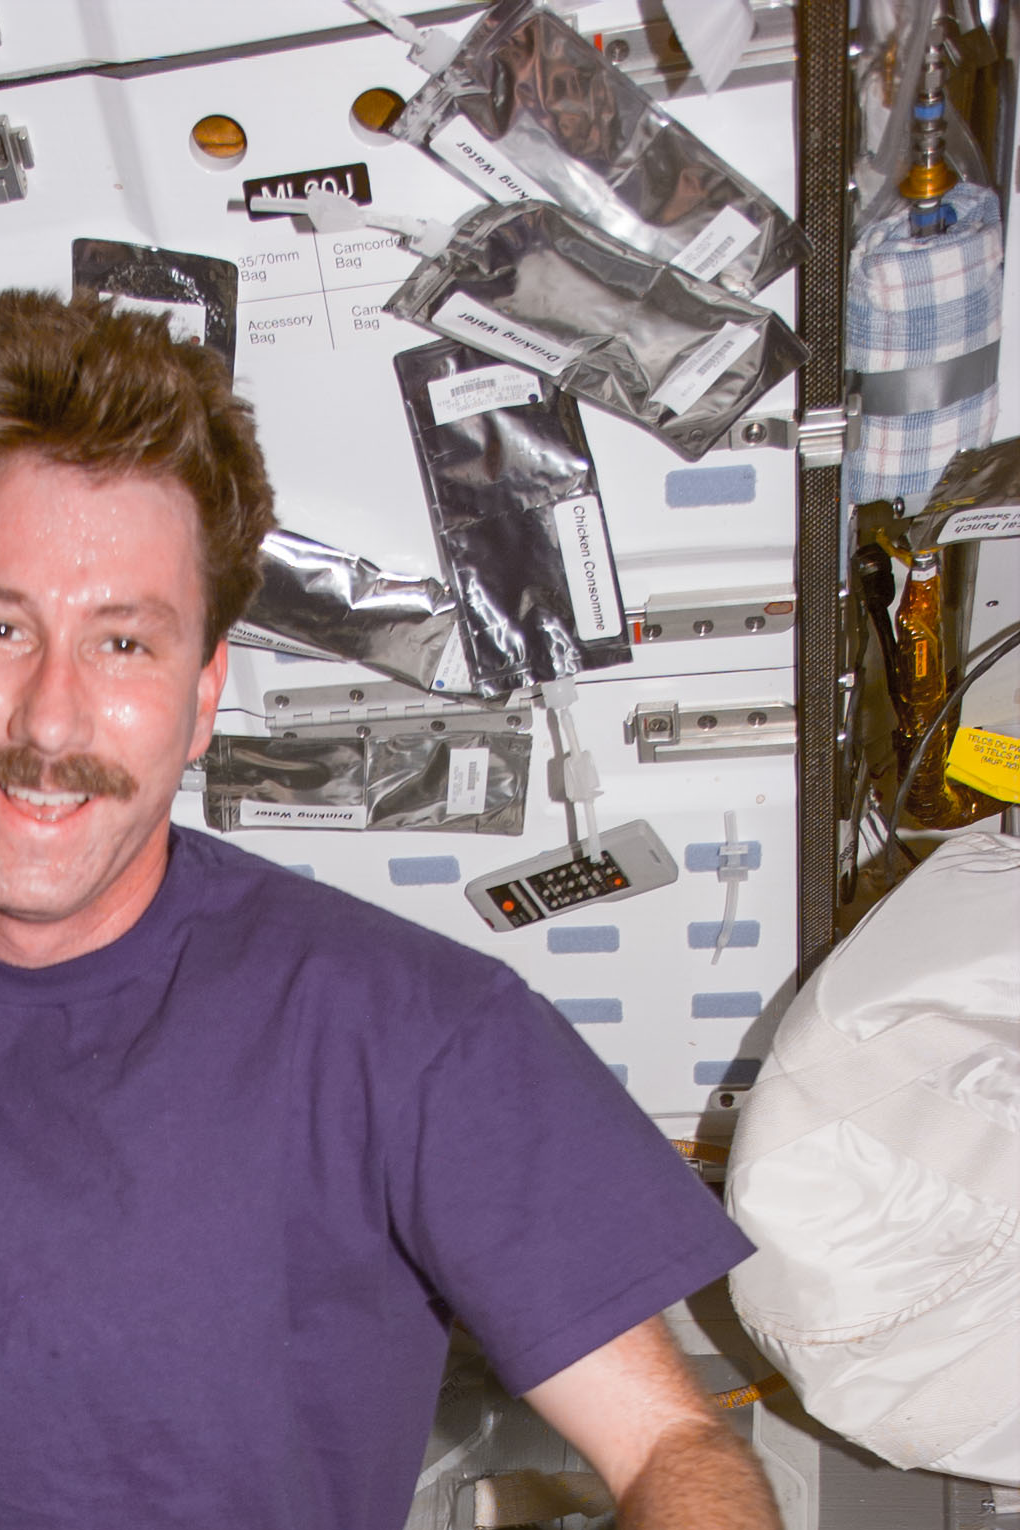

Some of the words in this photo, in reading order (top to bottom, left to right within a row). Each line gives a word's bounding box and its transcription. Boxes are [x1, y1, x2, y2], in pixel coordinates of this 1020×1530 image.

[456, 142, 496, 175] Water
[499, 175, 532, 201] king
[237, 250, 300, 269] 35/70mm
[335, 256, 363, 270] Bag
[240, 269, 268, 283] Bag
[247, 314, 314, 332] Accessory
[354, 317, 380, 331] Bag
[458, 312, 499, 335] Water
[250, 332, 276, 345] Bag
[502, 332, 561, 363] Drinking
[954, 521, 999, 534] Punch
[573, 505, 591, 558] Chicken
[583, 560, 605, 632] Consomme
[255, 810, 292, 819] Water
[297, 811, 353, 821] Drinking
